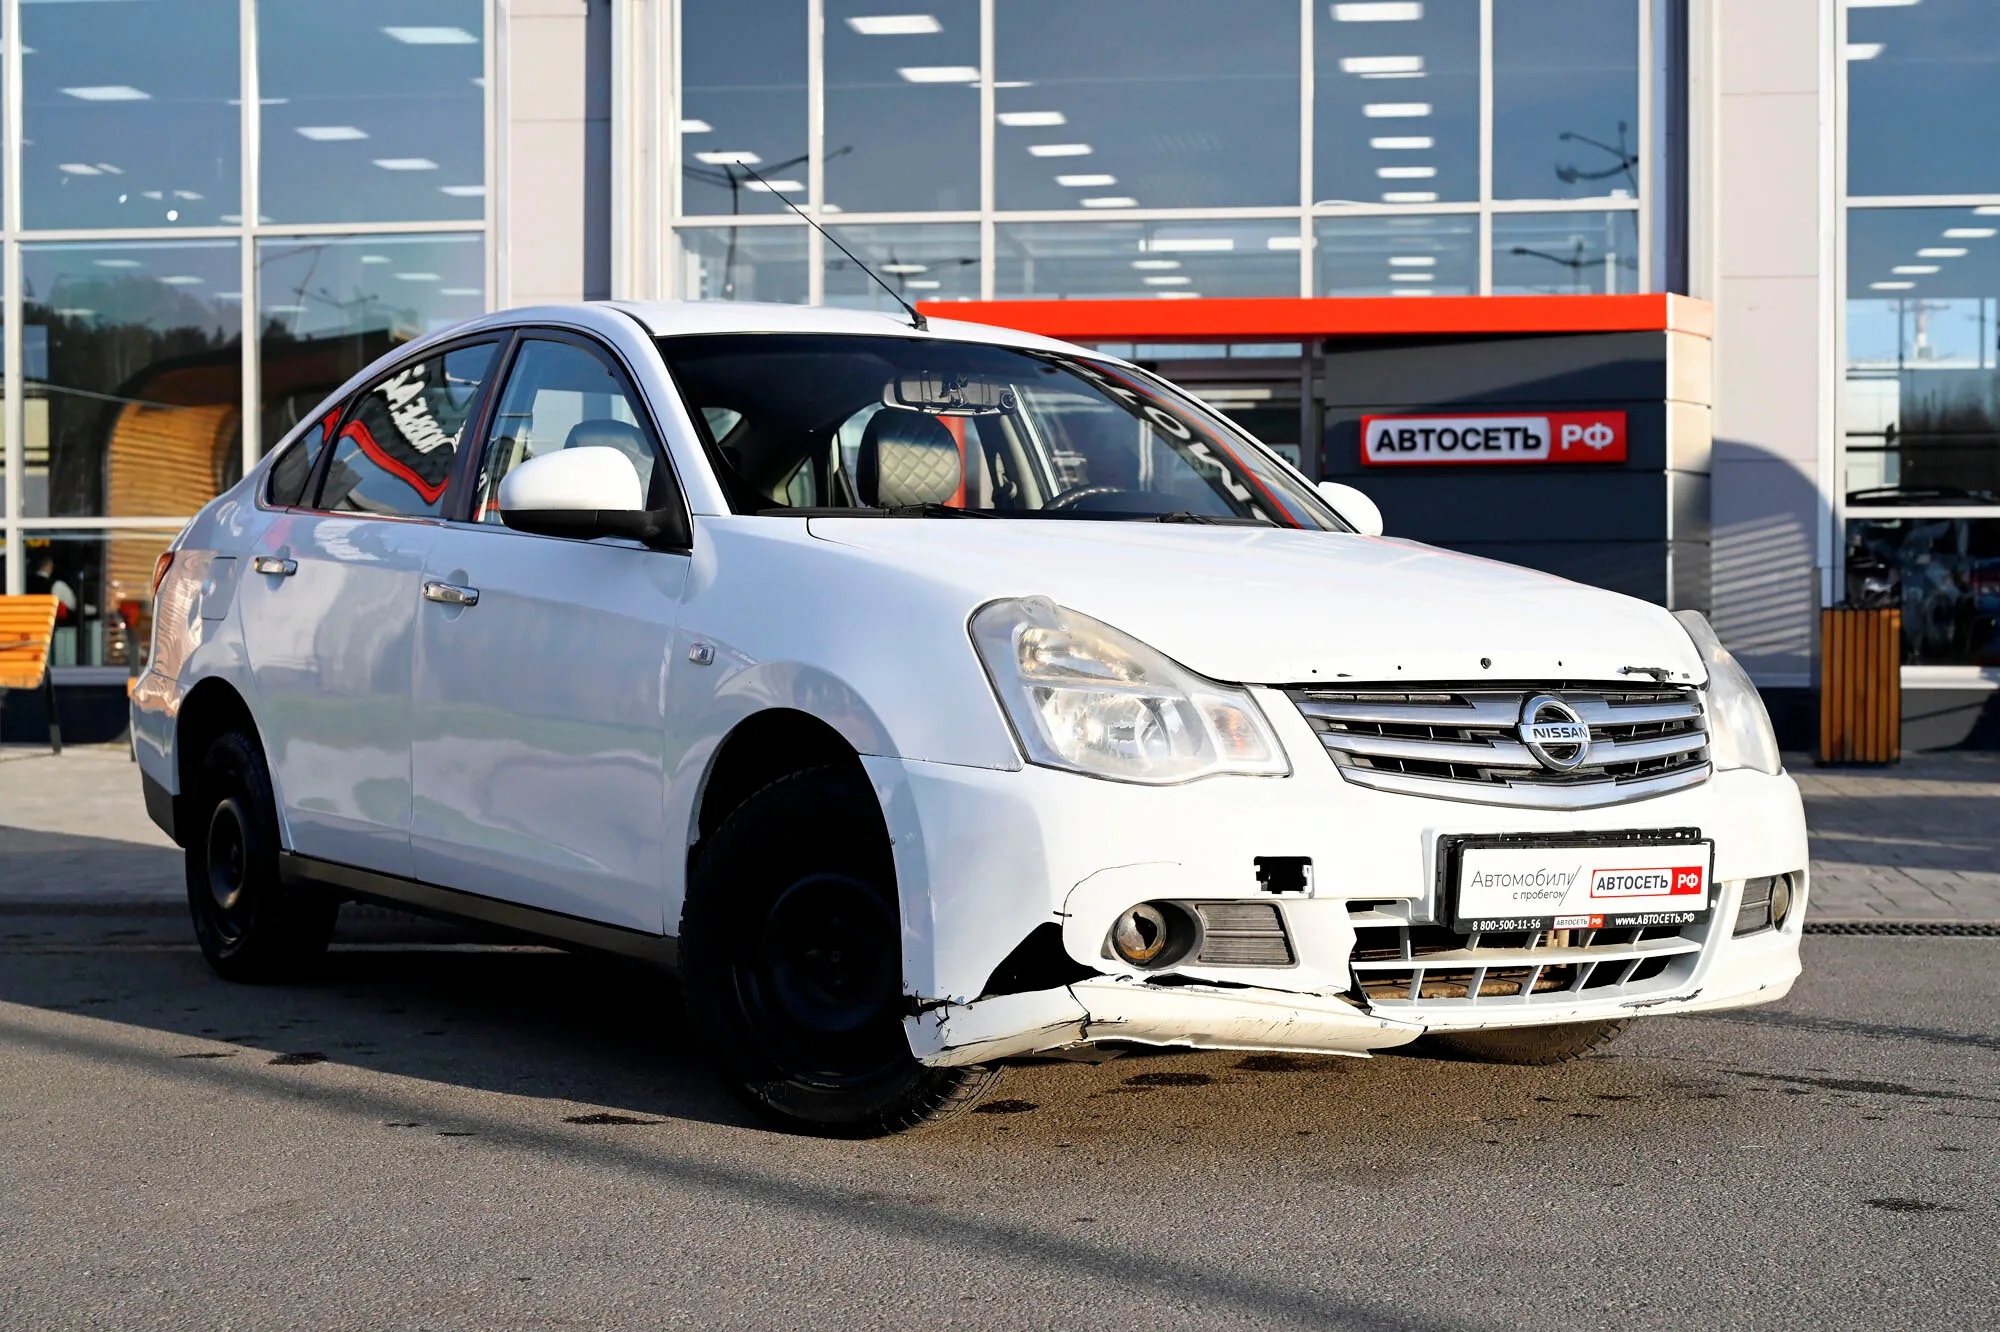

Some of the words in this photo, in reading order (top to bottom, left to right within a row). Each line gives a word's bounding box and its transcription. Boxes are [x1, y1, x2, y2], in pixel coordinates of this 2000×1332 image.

[1375, 426, 1542, 452] АВТОСЕТЬ
[1560, 422, 1615, 450] РФ
[1532, 727, 1588, 739] NISSAN
[1596, 875, 1669, 890] АВТОСЕТЬ
[1677, 873, 1699, 889] РФ
[1512, 892, 1519, 900] с
[1520, 889, 1565, 902] пробегом
[1472, 921, 1479, 931] 8
[1480, 919, 1541, 931] 800-500-11-56
[1556, 918, 1588, 926] АВТОСЕТЬ
[1591, 917, 1602, 925] РФ
[1615, 912, 1695, 926] www.АВТОСЕТЬ.РФ
